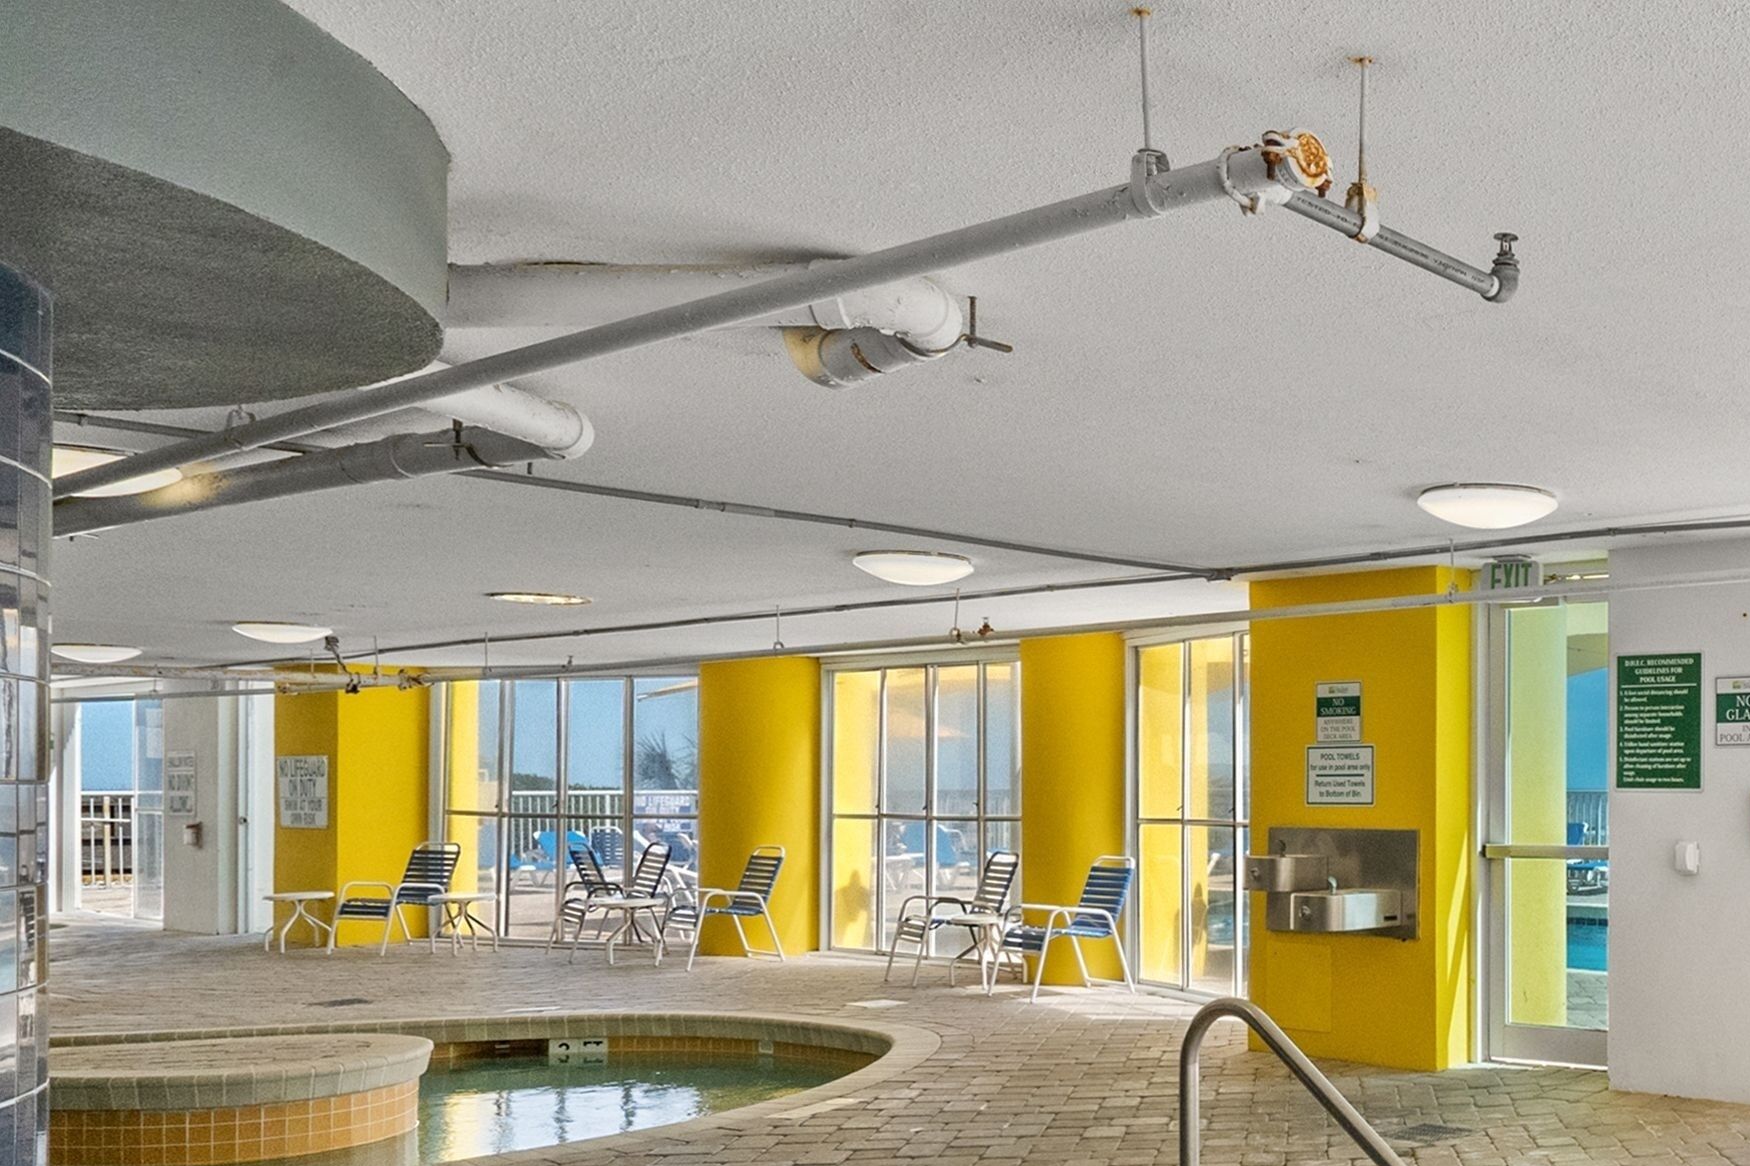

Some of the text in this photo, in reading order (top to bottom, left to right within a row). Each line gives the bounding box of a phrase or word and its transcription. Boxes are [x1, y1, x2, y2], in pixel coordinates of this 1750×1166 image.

[1490, 562, 1532, 589] EXIT
[1647, 658, 1694, 666] RECOMMENDED
[1332, 698, 1345, 706] NO
[1320, 706, 1357, 715] SMOKING
[1720, 733, 1745, 742] POOL
[280, 759, 326, 777] NO LIFEGUARD
[289, 779, 317, 797] ON DUTY
